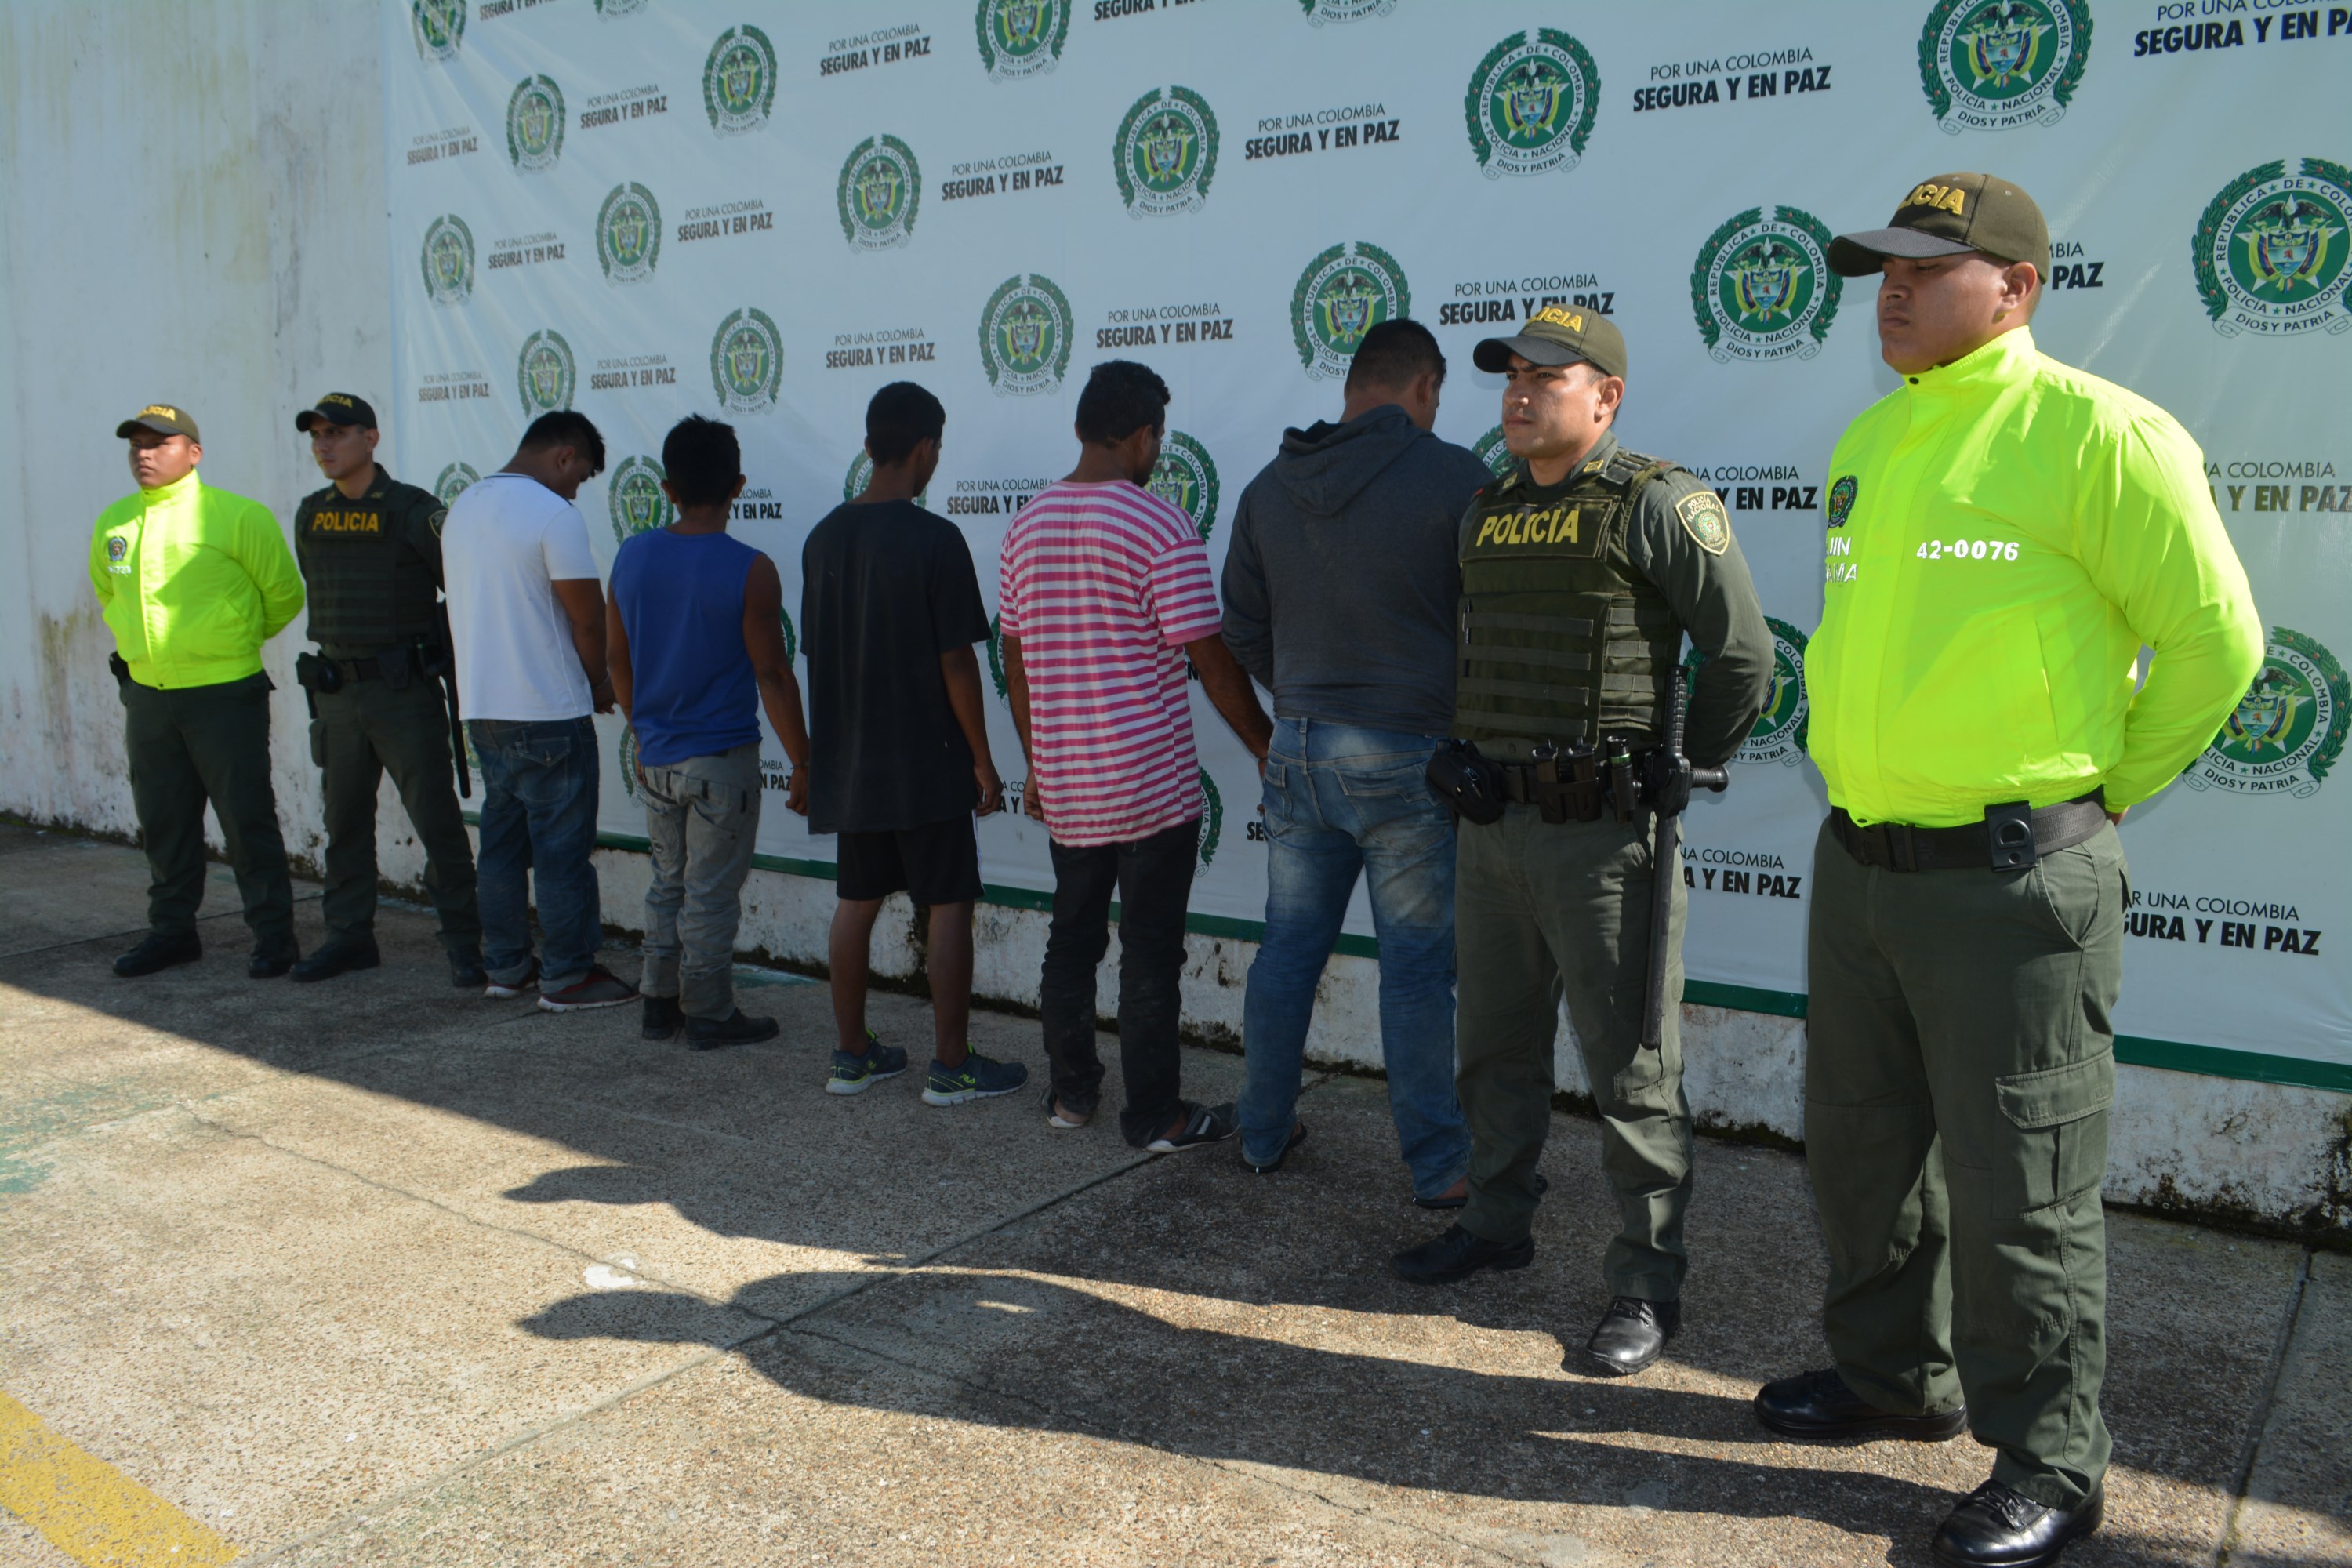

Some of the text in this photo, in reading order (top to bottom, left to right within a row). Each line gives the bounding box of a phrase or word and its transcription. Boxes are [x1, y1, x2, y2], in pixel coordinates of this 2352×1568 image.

[2158, 2, 2194, 21] POR
[2202, 0, 2247, 15] UNA
[829, 24, 920, 52] POR UNA COLOMBIA
[2134, 20, 2244, 57] SEGURA
[2253, 16, 2273, 43] Y
[2281, 10, 2318, 40] EN
[820, 36, 931, 76] SEGURA Y EN PAZ
[1651, 47, 1813, 81] POR UNA COLOMBIA
[1633, 65, 1831, 112] SEGURA Y EN PAZ
[581, 96, 667, 129] SEGURA Y EN PAZ
[1259, 103, 1385, 132] POR UNA COLOMBIA
[1245, 119, 1399, 160] SEGURA Y EN PAZ
[952, 151, 1052, 176] POR UNA COLOMBIA
[942, 165, 1063, 201] SEGURA Y EN PAZ
[2284, 179, 2304, 189] DE
[685, 209, 700, 220] POR
[702, 206, 720, 218] UNA
[678, 212, 773, 242] SEGURA Y EN PAZ
[524, 249, 530, 263] Y
[533, 247, 544, 263] EN
[546, 243, 565, 260] PAZ
[1762, 223, 1777, 233] DE
[1790, 228, 1824, 289] COLOMBIA
[1455, 274, 1598, 297] POR UNA COLOMBIA
[2052, 261, 2104, 290] PAZ
[2285, 270, 2351, 315] NACIONAL
[1108, 303, 1221, 323] POR UNA COLOMBIA
[1439, 299, 1515, 325] SEGURA
[1522, 296, 1535, 319] Y
[1766, 303, 1819, 343] NACIONAL
[2235, 310, 2335, 332] DIOS Y PATRIA
[835, 328, 924, 346] POR UNA COLOMBIA
[1097, 319, 1233, 348] SEGURA Y EN PAZ
[826, 342, 935, 368] SEGURA Y EN PAZ
[1726, 339, 1804, 358] DIOS Y PATRIA
[591, 367, 676, 390] SEGURA Y EN PAZ
[1715, 466, 1799, 481] COLOMBIA
[2227, 462, 2336, 478] COLOMBIA
[956, 481, 975, 492] POR
[978, 480, 1000, 491] UNA
[1736, 487, 1763, 510] EN
[1772, 486, 1818, 510] PAZ
[2227, 485, 2247, 511] Y
[2254, 485, 2291, 511] EN
[2299, 485, 2352, 512] PAZ
[732, 503, 782, 519] Y EN PAZ
[947, 495, 1000, 514] SEGURA
[1003, 495, 1012, 514] Y
[1686, 503, 1720, 523] NACIONAL
[313, 511, 379, 532] POLICIA
[1475, 509, 1579, 547] POLICIA
[1916, 539, 2020, 561] 42-0076
[2289, 655, 2328, 724] COLOMBIA
[2252, 739, 2320, 775] NACIONAL
[2205, 768, 2235, 788] DIOS
[2251, 775, 2299, 791] PATRIA
[1702, 848, 1784, 869] COLOMBIA
[1702, 868, 1717, 890] Y
[1722, 870, 1750, 894] EN
[1757, 873, 1802, 899] PAZ
[2148, 892, 2190, 910] UNA
[2195, 897, 2299, 921] COLOMBIA
[2195, 918, 2214, 943] Y
[2220, 921, 2256, 949] EN
[2263, 925, 2322, 956] PAZ
